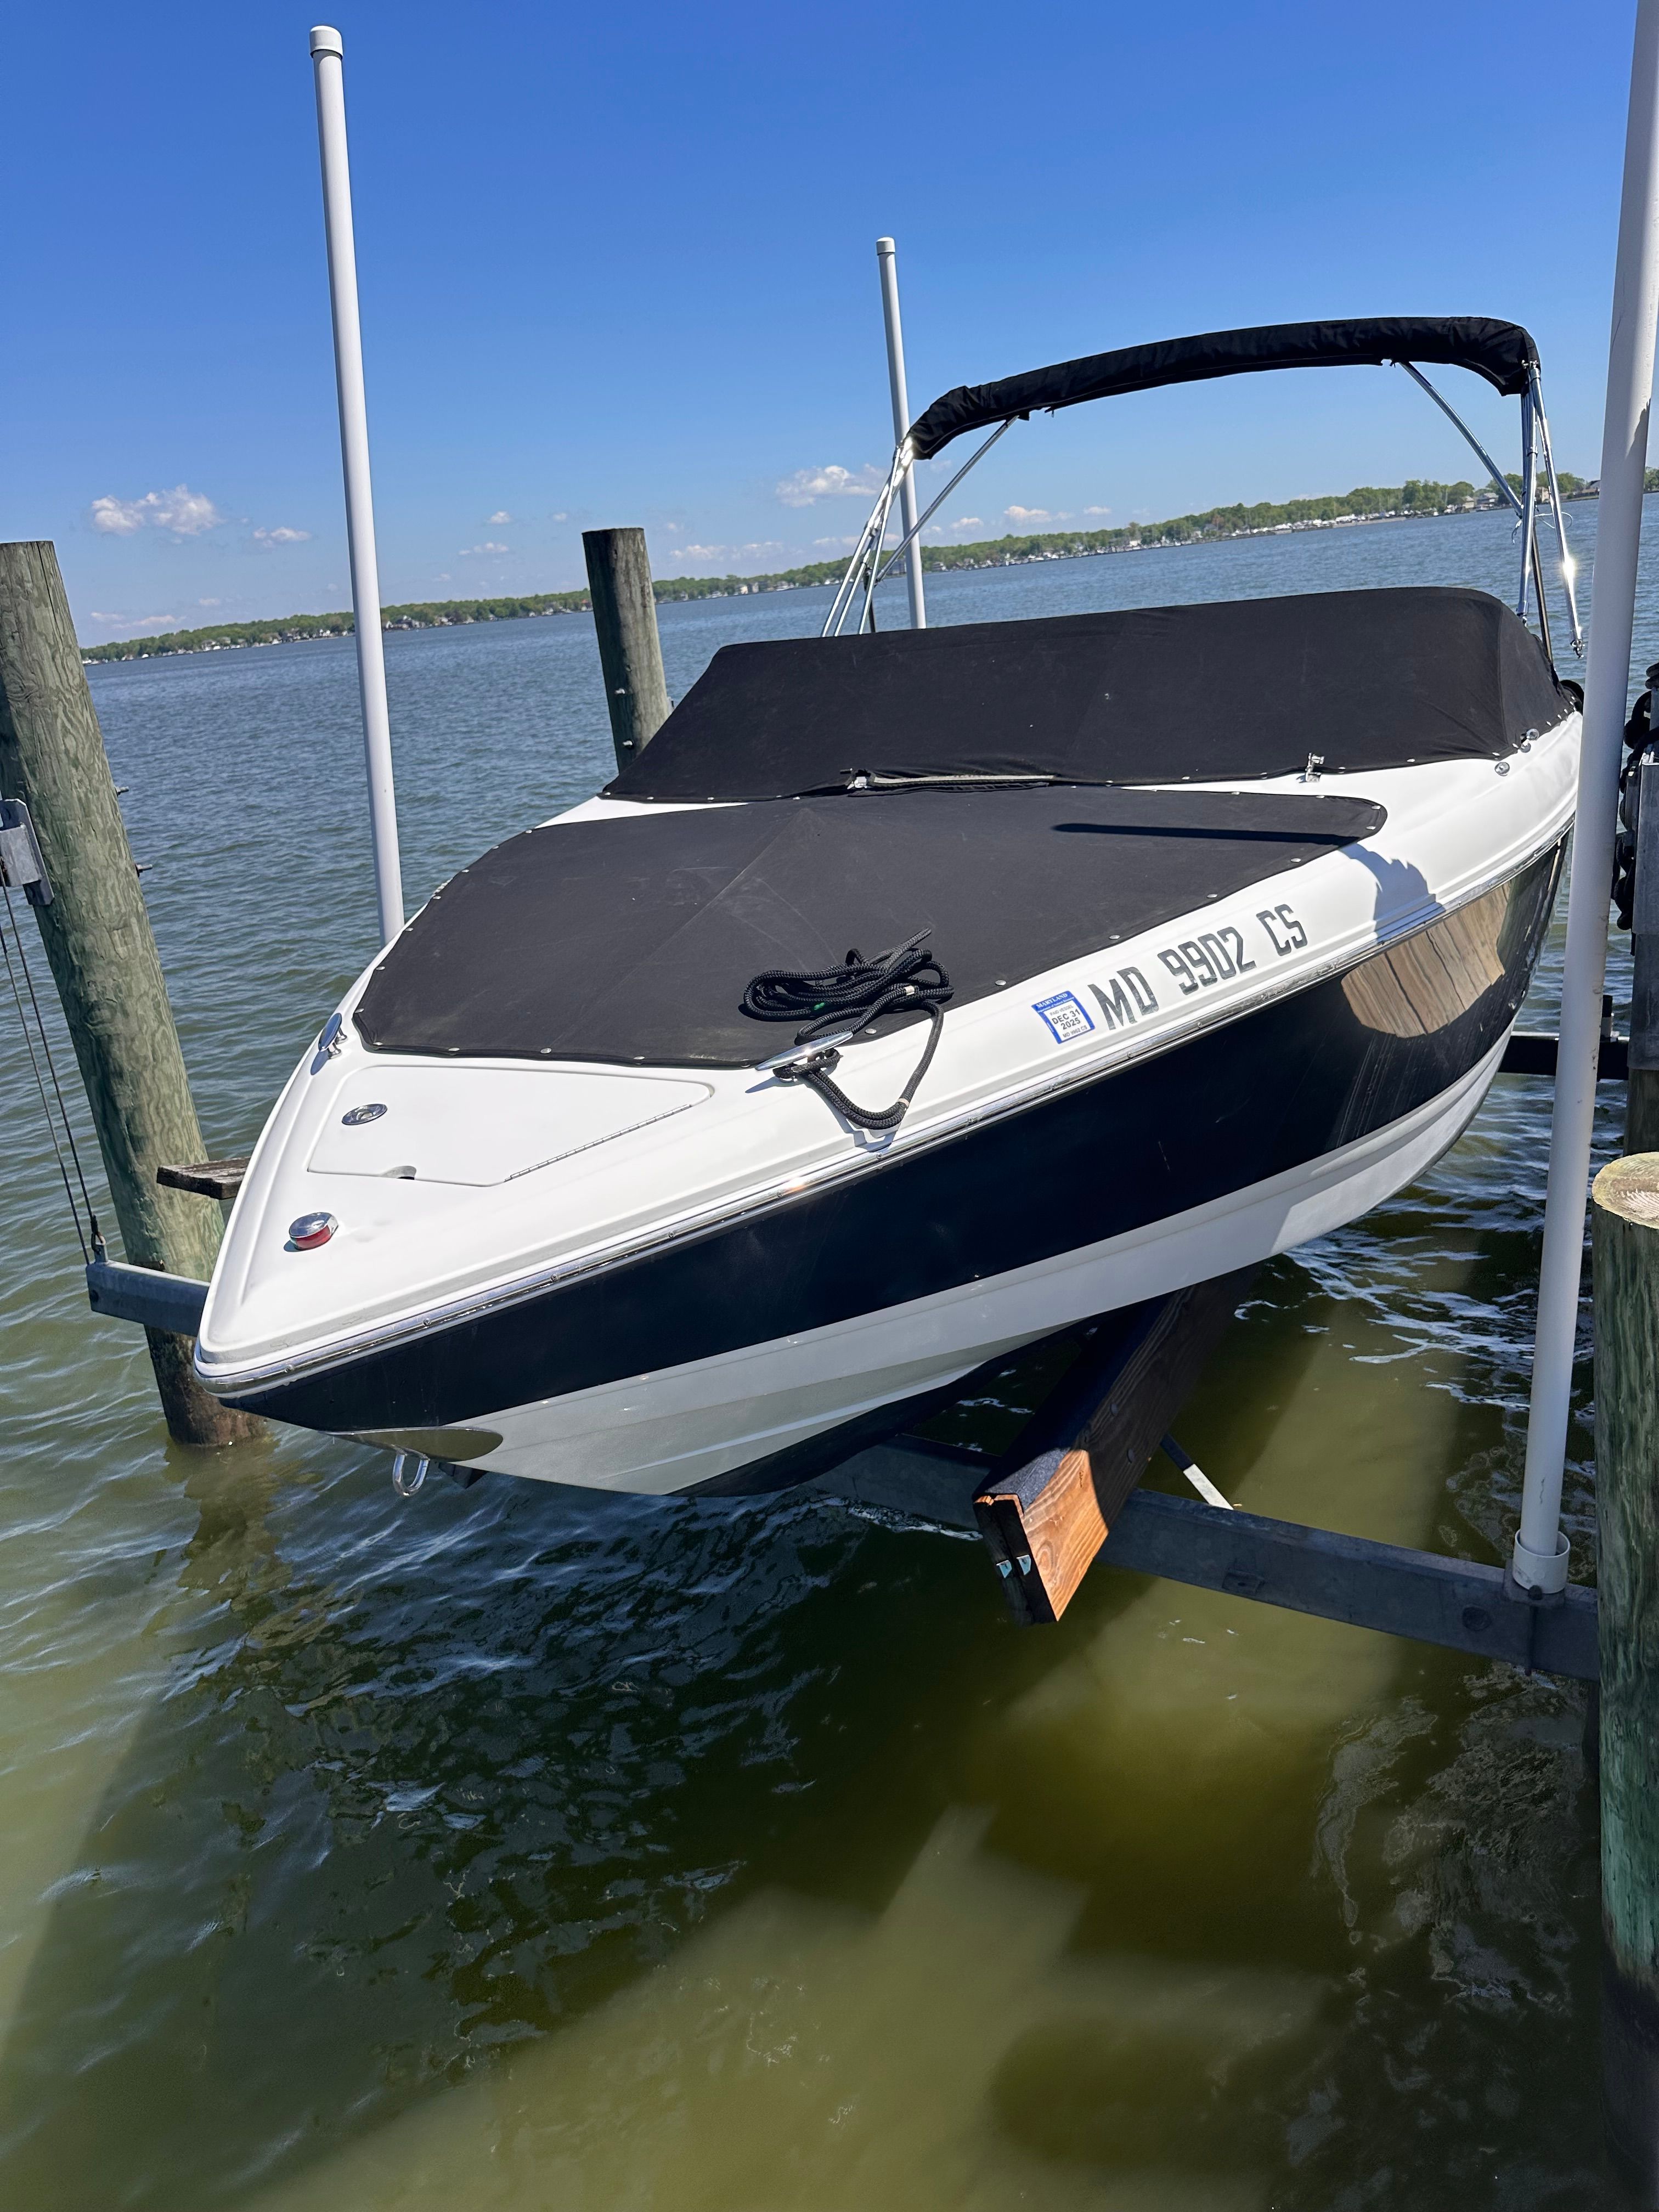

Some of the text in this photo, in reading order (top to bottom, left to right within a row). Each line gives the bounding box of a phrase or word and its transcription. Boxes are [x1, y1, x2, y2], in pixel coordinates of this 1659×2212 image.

[1088, 904, 1308, 1030] MD 9902 CS
[1036, 993, 1068, 1008] MARYLAND
[1052, 1008, 1081, 1024] DEC 31
[1060, 1017, 1081, 1030] 2025
